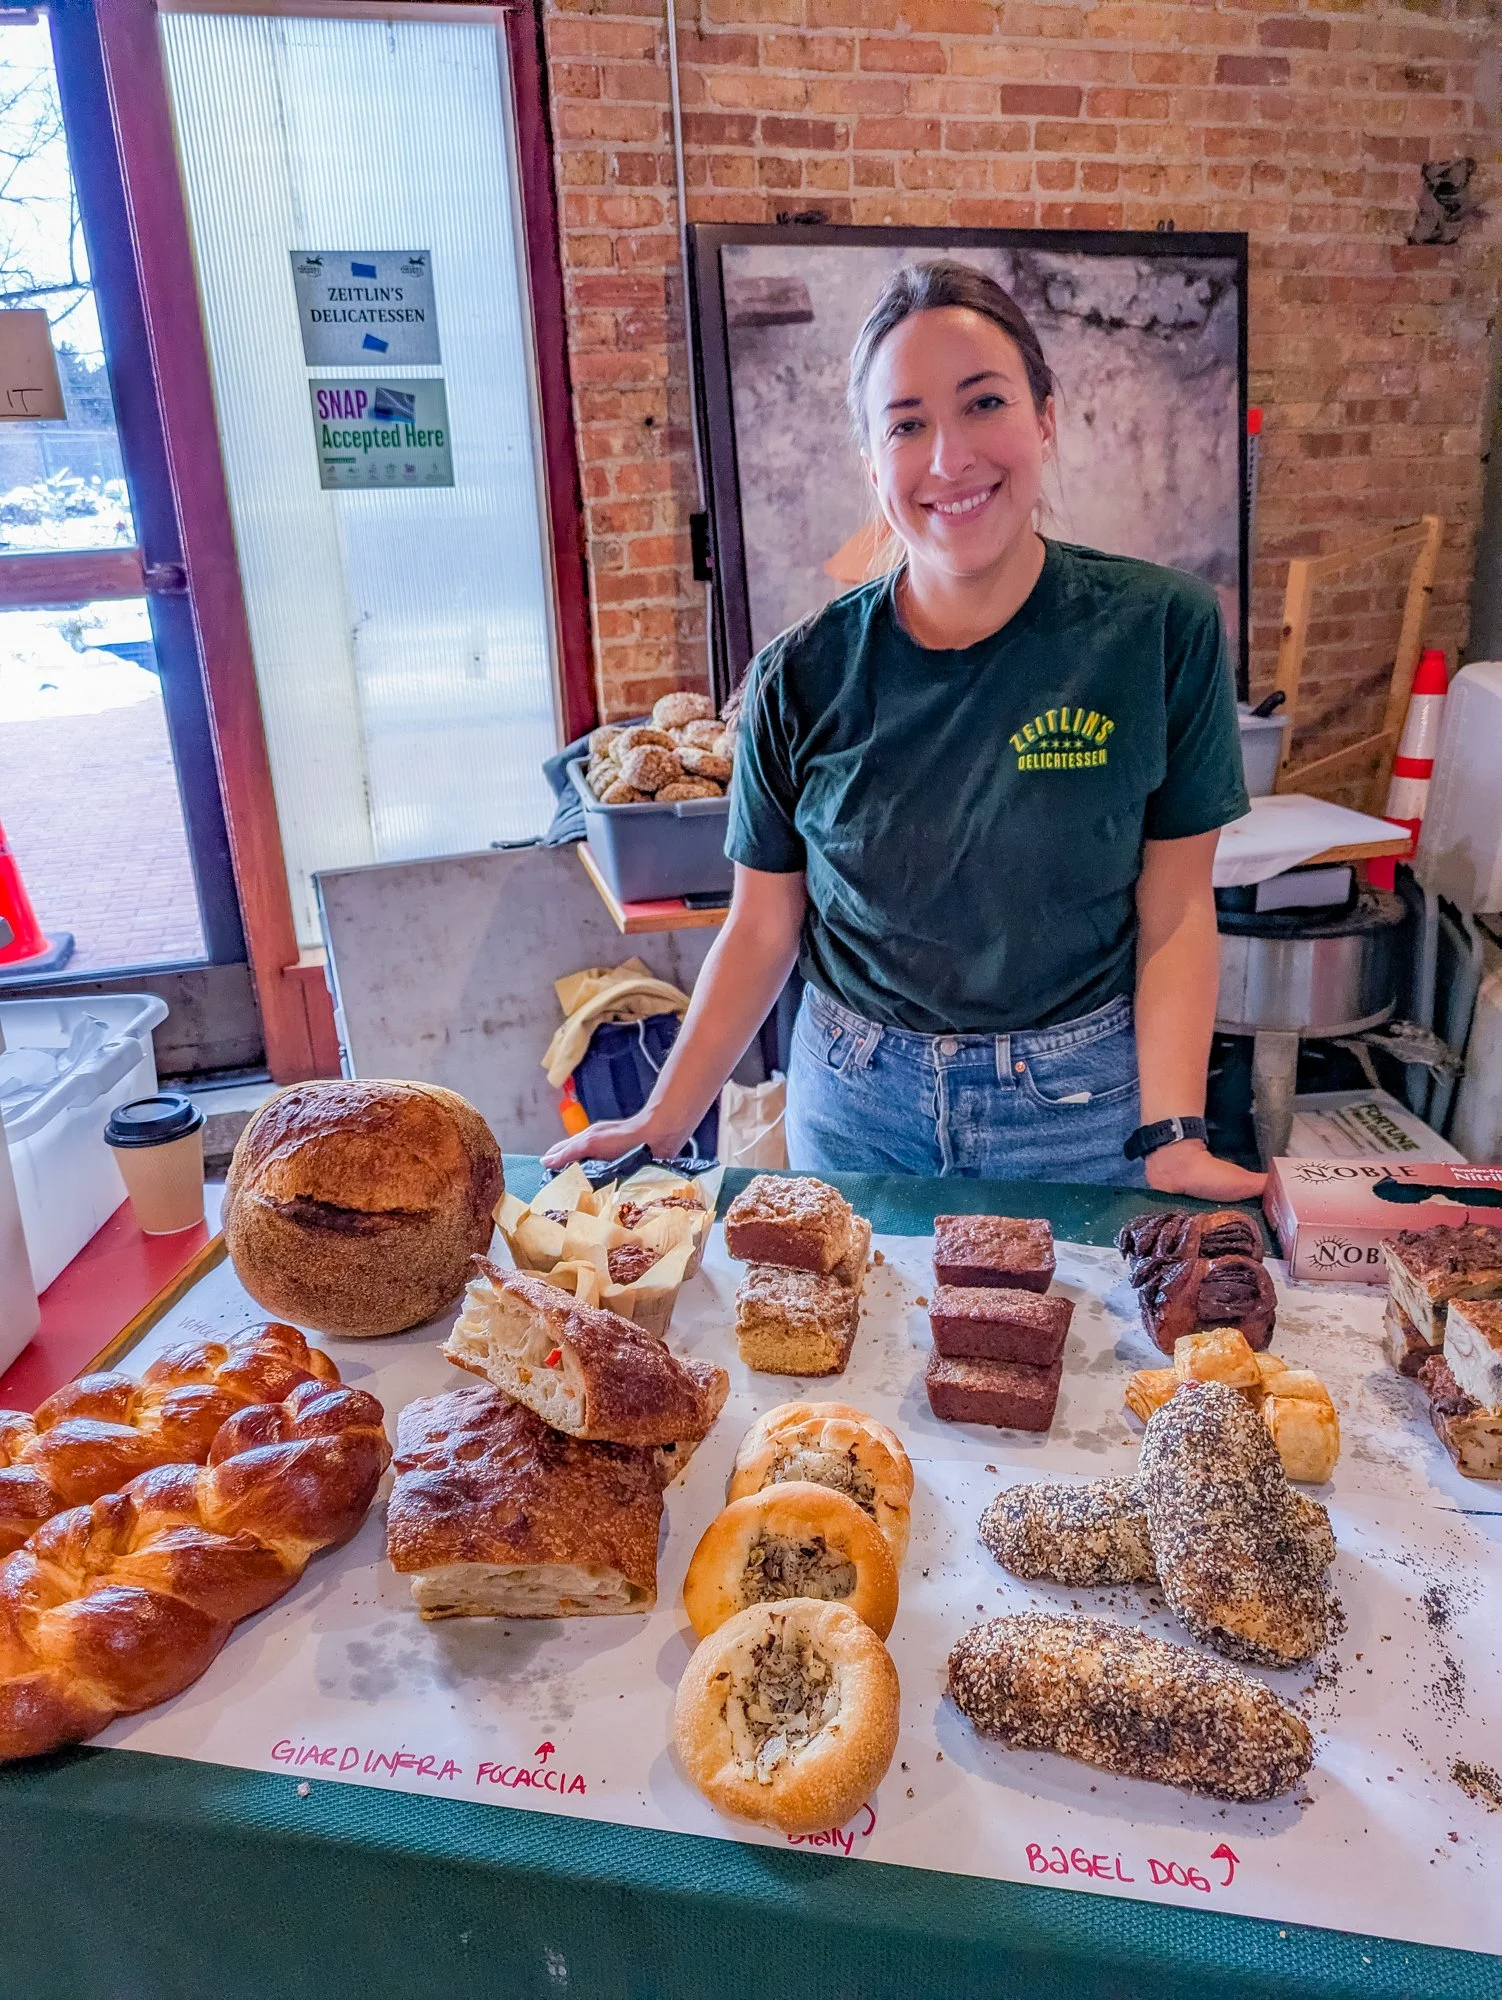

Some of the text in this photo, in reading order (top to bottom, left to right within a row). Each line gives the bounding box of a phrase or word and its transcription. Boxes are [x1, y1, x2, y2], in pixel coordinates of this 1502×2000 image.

[327, 287, 404, 302] ZEITLIN'S
[310, 309, 425, 323] DELICATESSEN
[316, 388, 368, 421] SNAP
[321, 421, 444, 454] Accepted Here
[1009, 706, 1116, 753] ZEITLIN'S
[1018, 748, 1108, 771] DELICATESSEN
[1302, 1165, 1418, 1179] NOBLE
[1319, 1245, 1387, 1265] NOB
[475, 1761, 587, 1795] FOCACCIA
[1147, 1858, 1211, 1893] DOG
